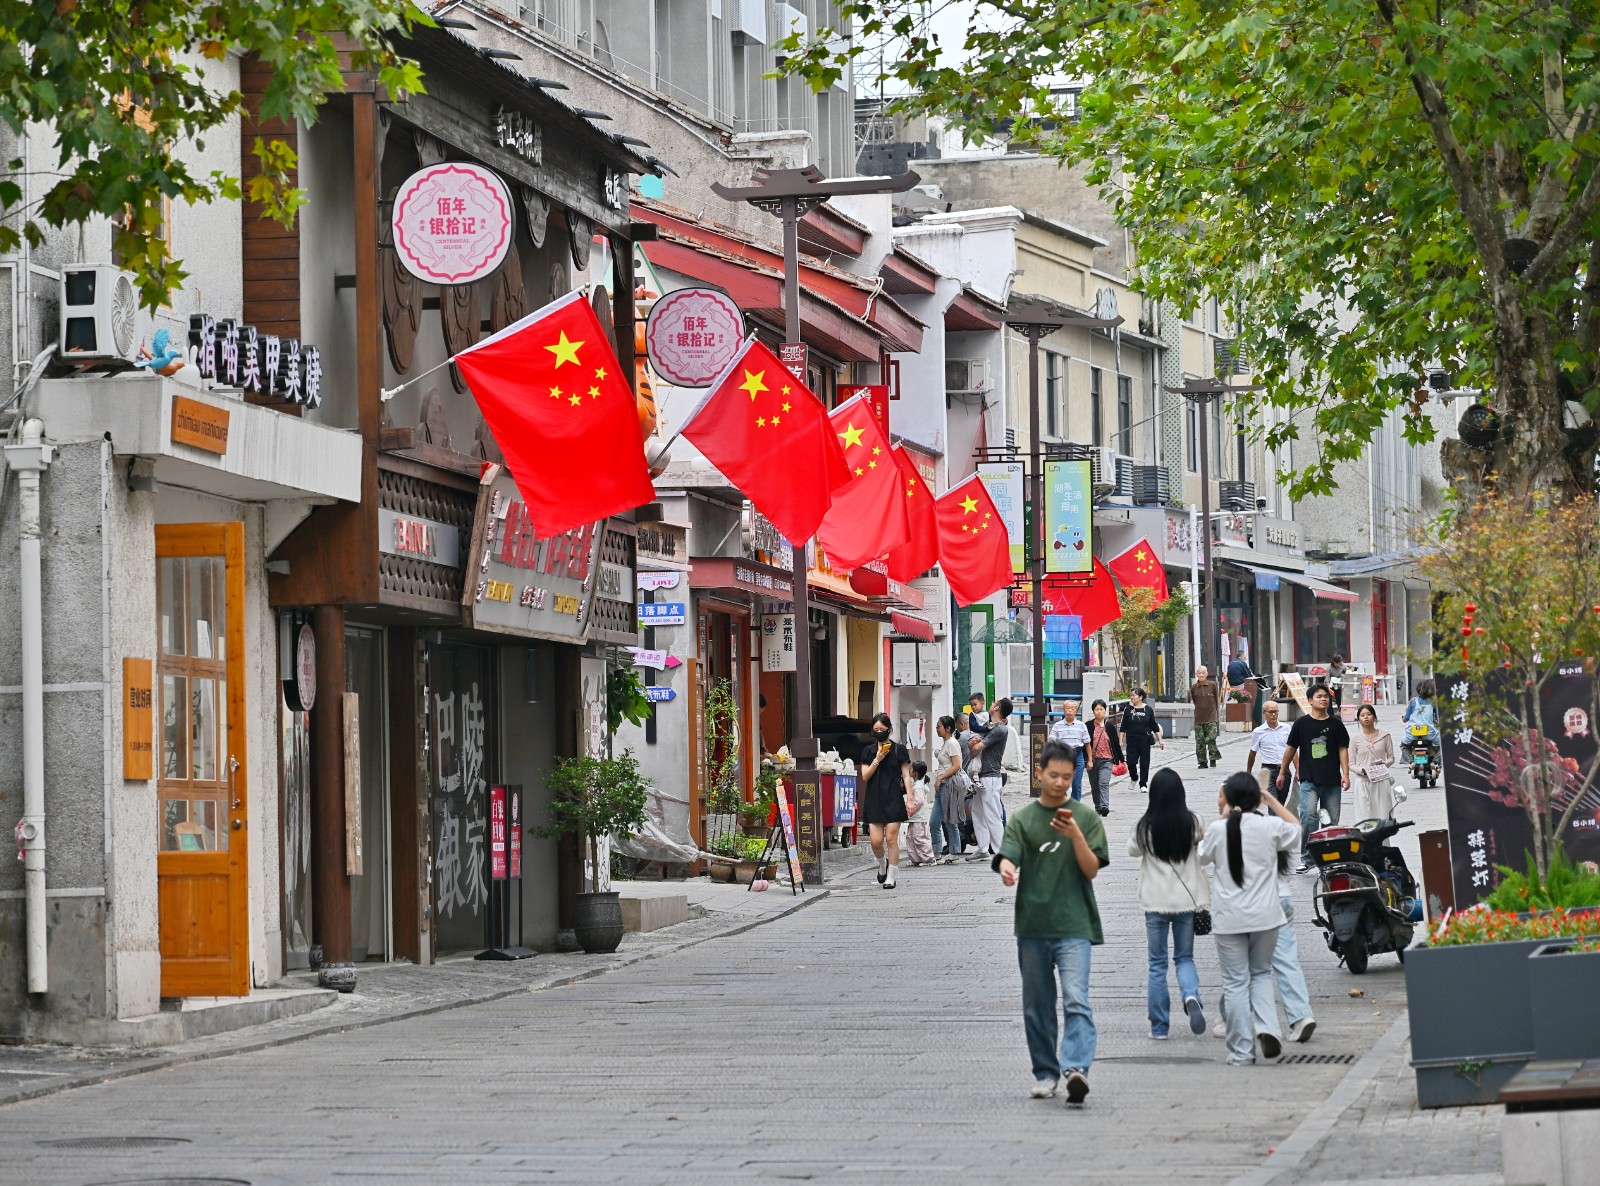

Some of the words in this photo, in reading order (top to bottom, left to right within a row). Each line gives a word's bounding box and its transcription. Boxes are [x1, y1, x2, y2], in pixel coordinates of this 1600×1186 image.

[437, 197, 466, 215] 佰年
[429, 217, 476, 235] 银拾记
[683, 316, 708, 331] 佰年
[676, 332, 715, 347] 银拾记
[199, 314, 323, 408] 指喵美甲美睫
[177, 410, 200, 434] zhimiao
[201, 419, 227, 442] manicure
[1064, 490, 1083, 501] 生活
[1060, 501, 1079, 514] 指南
